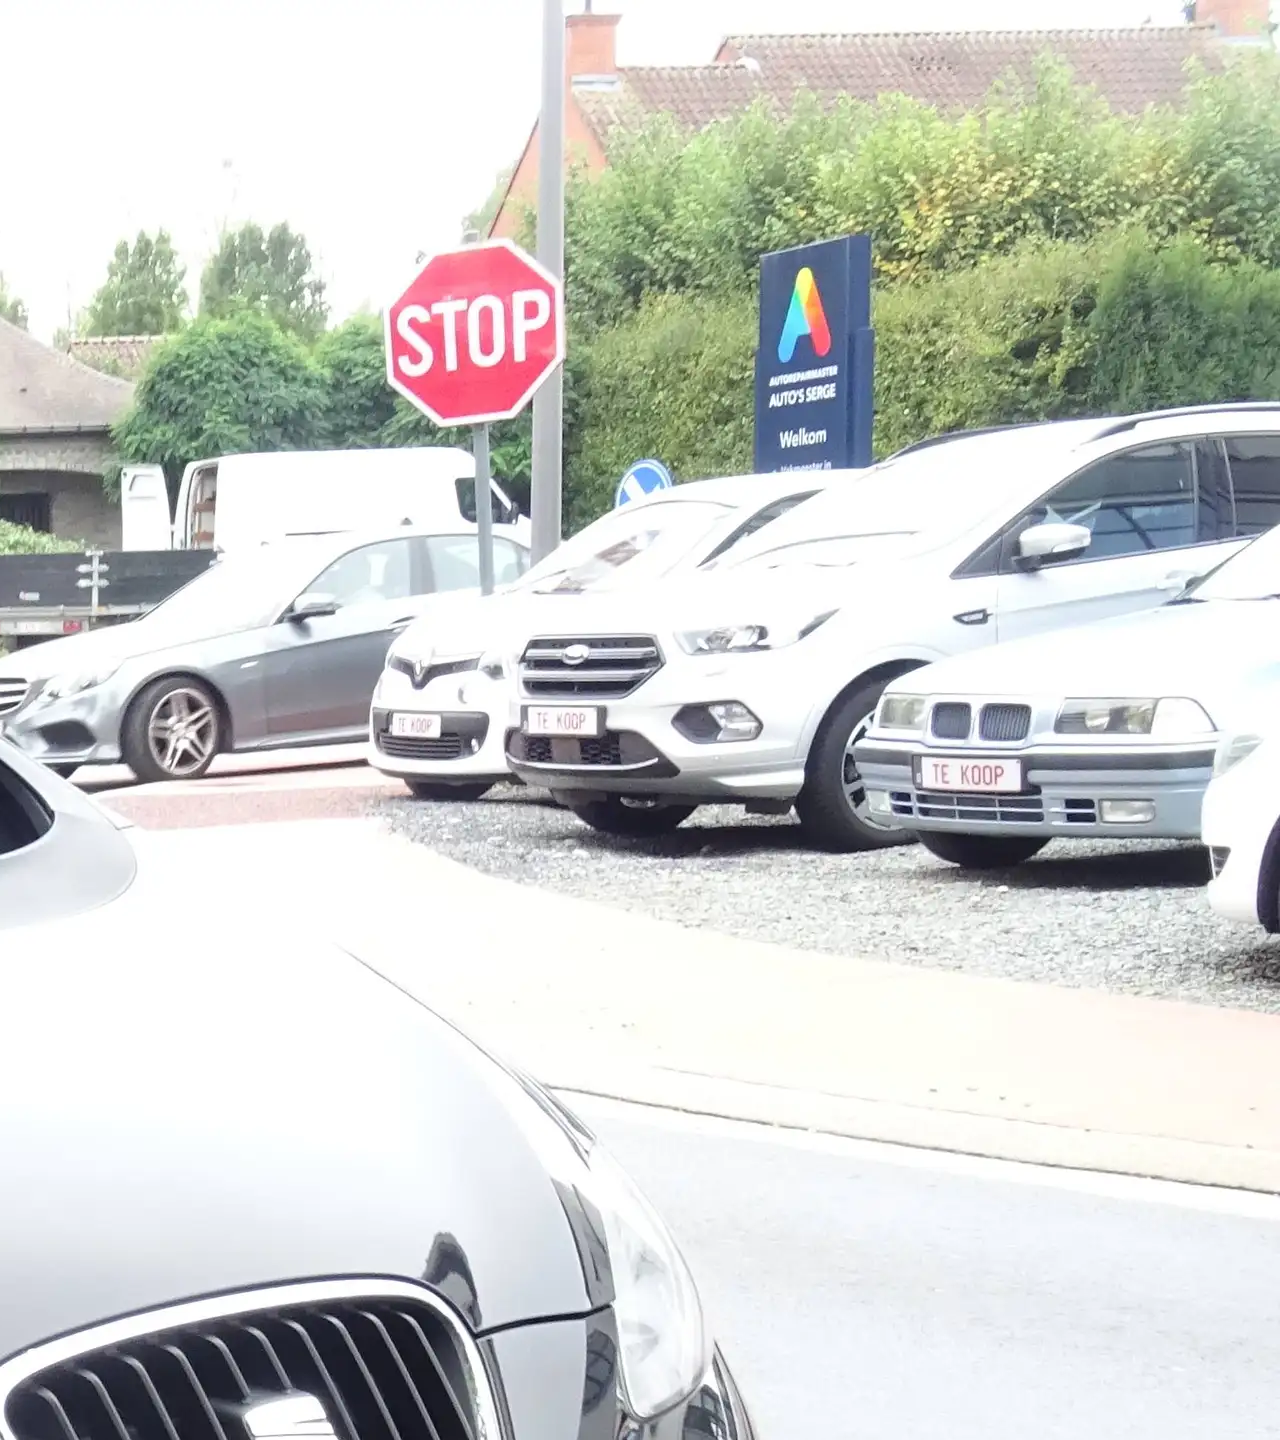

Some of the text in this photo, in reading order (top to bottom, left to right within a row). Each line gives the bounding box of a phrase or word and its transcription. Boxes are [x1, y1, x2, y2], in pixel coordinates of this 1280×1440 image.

[396, 288, 551, 378] STOP
[768, 382, 837, 408] AUTO'S SERGE
[779, 427, 827, 449] Welkom
[397, 717, 433, 733] TE KOOP
[537, 711, 587, 731] TE KOOP
[932, 763, 1004, 785] TE KOOP
